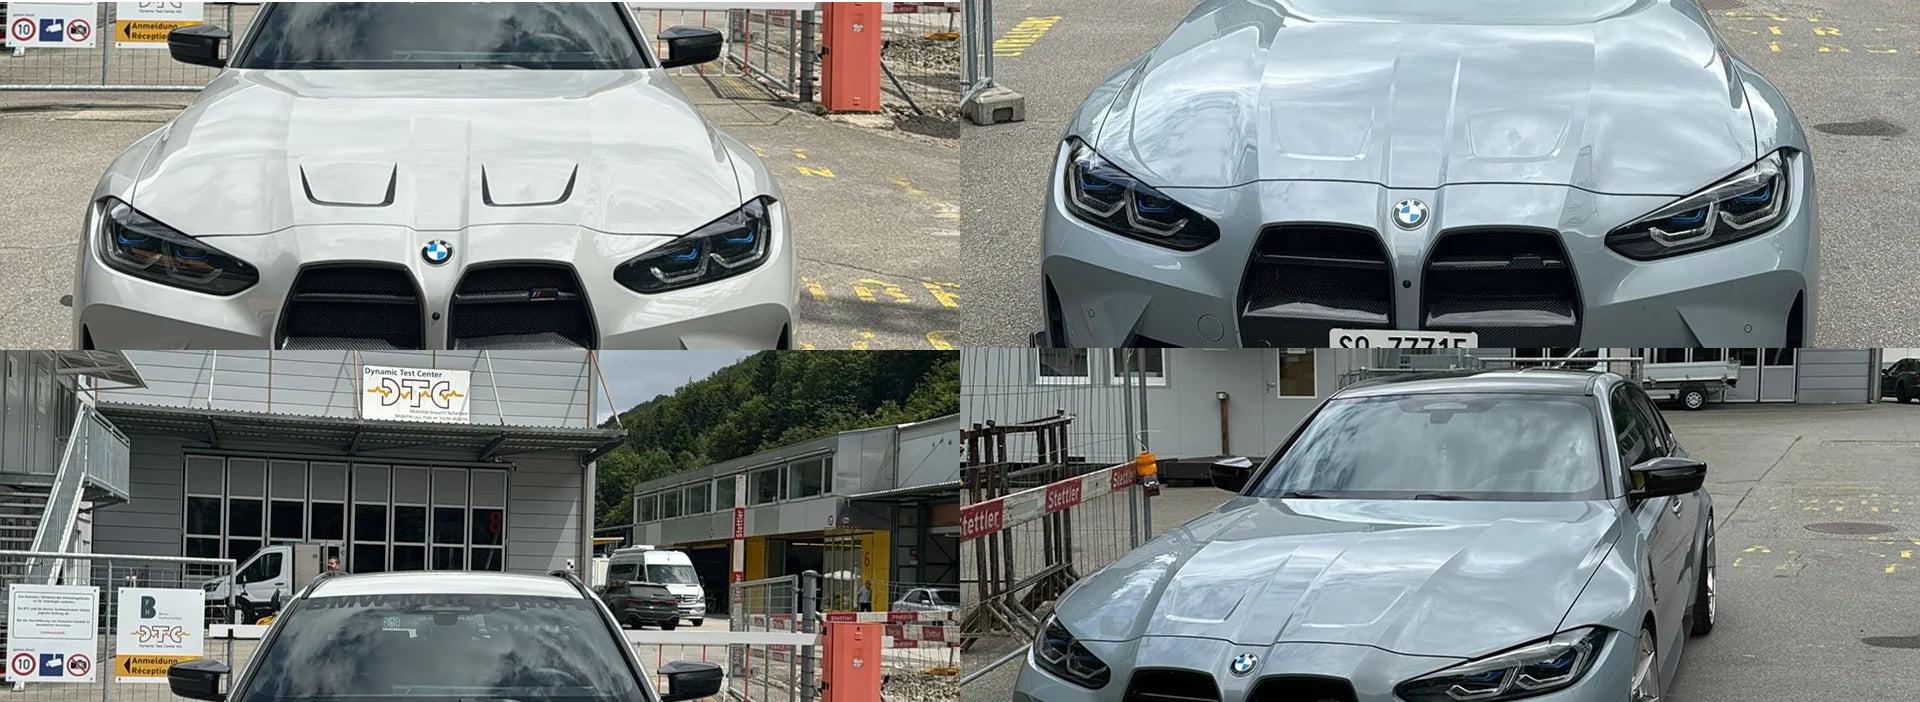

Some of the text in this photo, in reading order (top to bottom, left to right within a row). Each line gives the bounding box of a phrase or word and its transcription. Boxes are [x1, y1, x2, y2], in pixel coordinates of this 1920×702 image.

[18, 23, 30, 35] 10
[132, 31, 167, 40] Réceptio
[365, 367, 442, 378] Dynamic Test Center
[382, 377, 450, 409] DTC
[1048, 486, 1079, 510] Stettler
[864, 551, 870, 568] 6
[139, 625, 182, 643] DTC
[18, 659, 30, 670] 10
[132, 666, 167, 676] Réceptio
